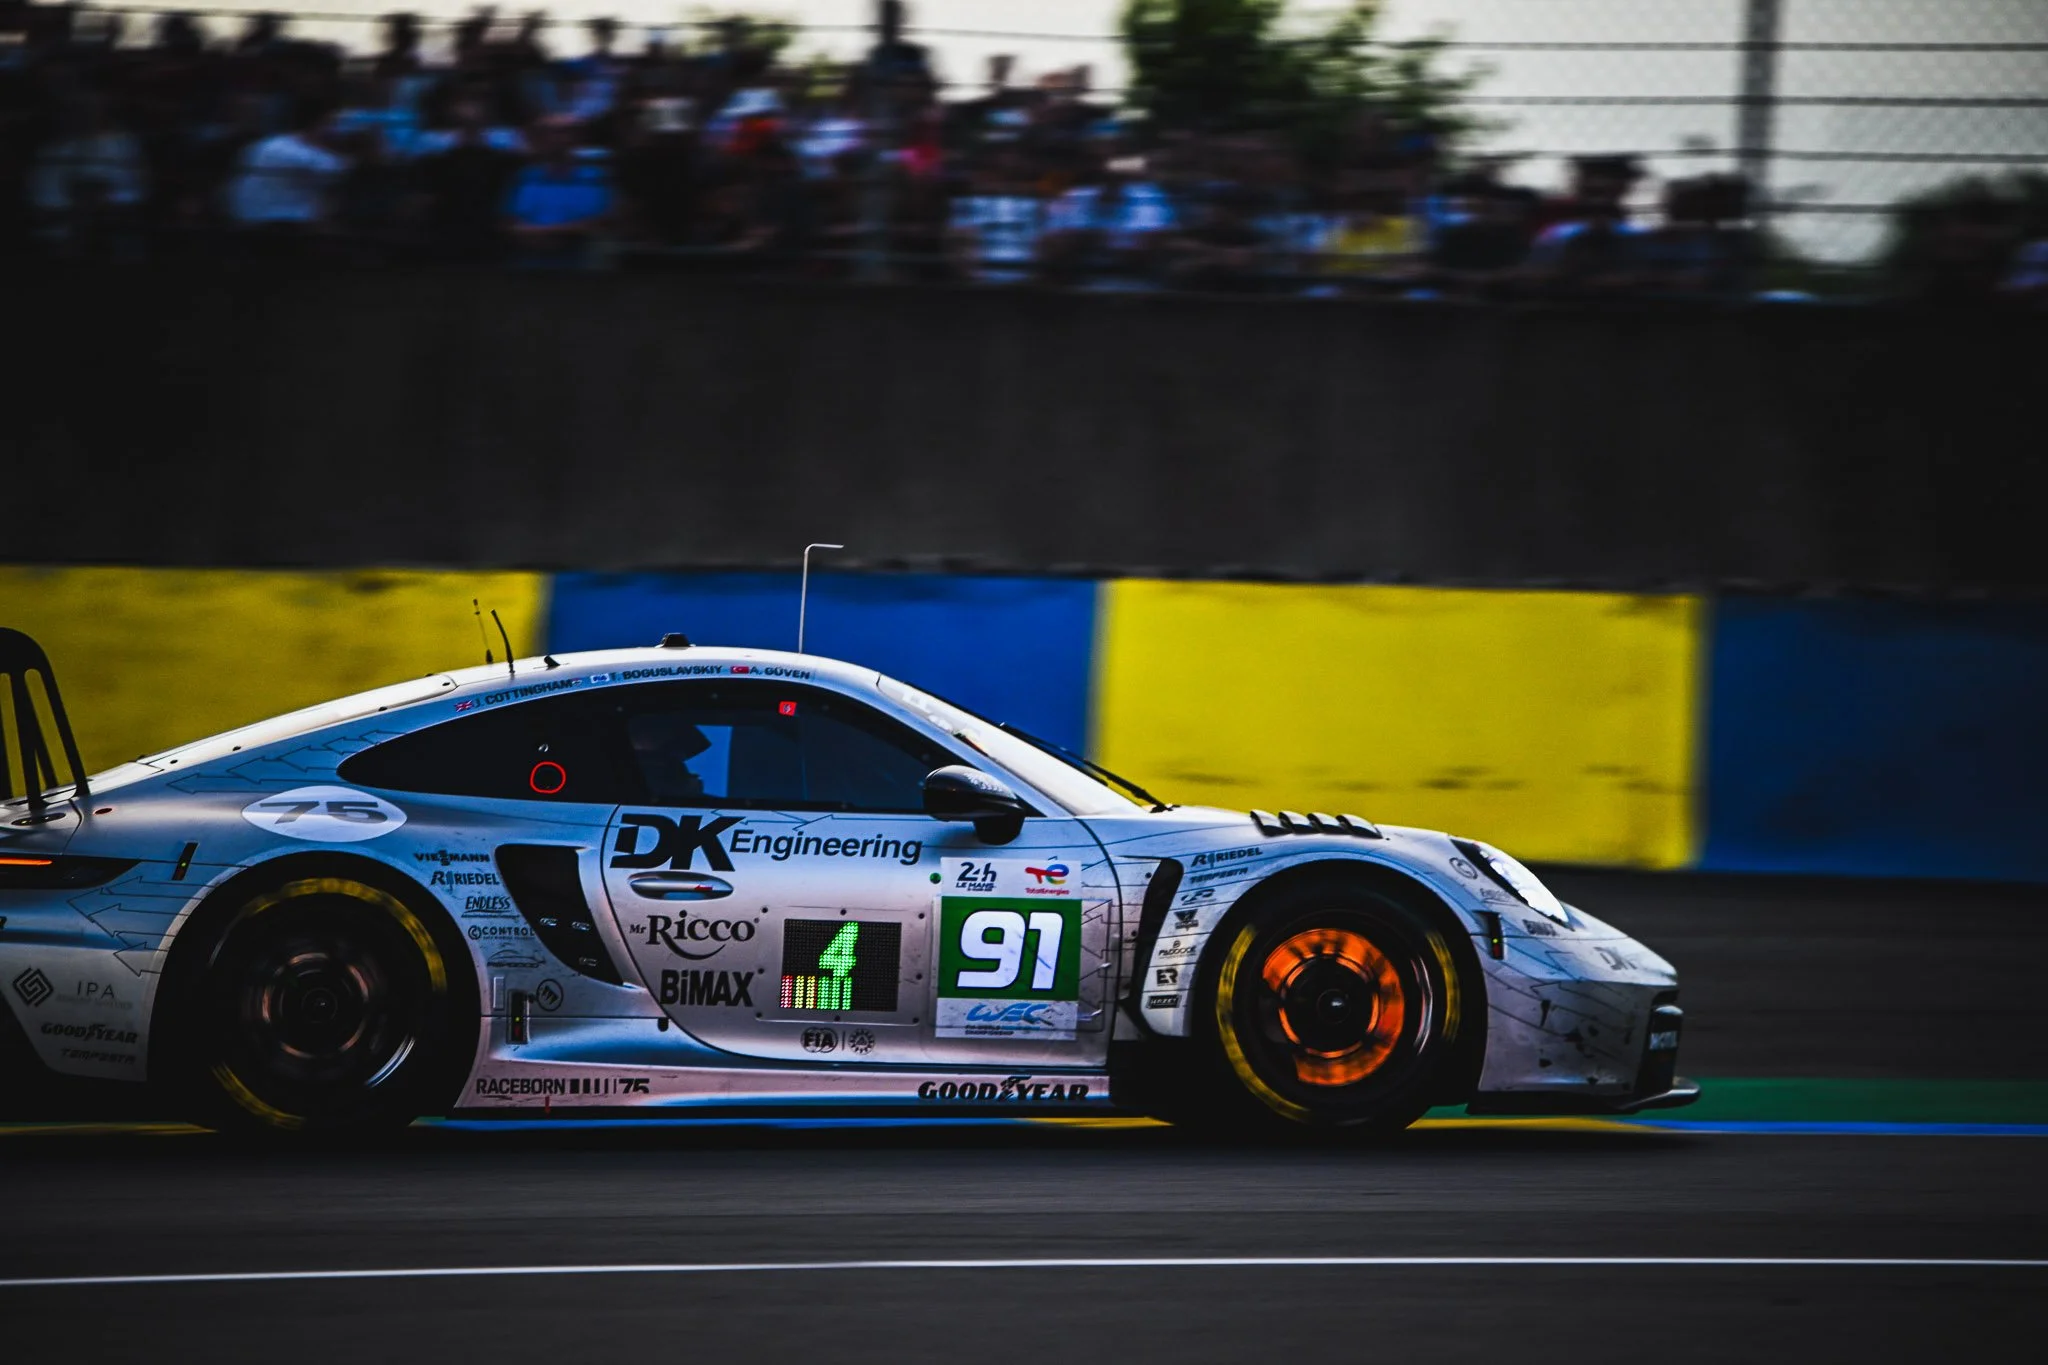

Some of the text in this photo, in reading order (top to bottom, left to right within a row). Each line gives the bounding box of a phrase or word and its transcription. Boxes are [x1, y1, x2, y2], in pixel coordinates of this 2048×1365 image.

[623, 665, 723, 680] BOGUSLAVSKIY
[764, 666, 811, 680] GÜVEN
[486, 679, 574, 705] COTTINGHAM
[259, 801, 388, 824] 75
[610, 813, 924, 871] DK Engineering
[1215, 847, 1263, 862] RIEDEL
[453, 873, 500, 885] RIEDEL
[957, 861, 997, 882] 24h
[464, 896, 511, 910] ENDLESS
[482, 926, 536, 936] CONTROL
[629, 911, 756, 959] Mr Ricco
[818, 921, 859, 977] 4
[957, 909, 1063, 990] 91
[77, 981, 115, 998] IPA
[660, 969, 754, 1007] BiMAX
[41, 1022, 138, 1044] GOODYEAR
[803, 1031, 835, 1048] FIA
[476, 1078, 650, 1095] RACEBORN 75
[918, 1077, 1090, 1101] GOODYEAR
